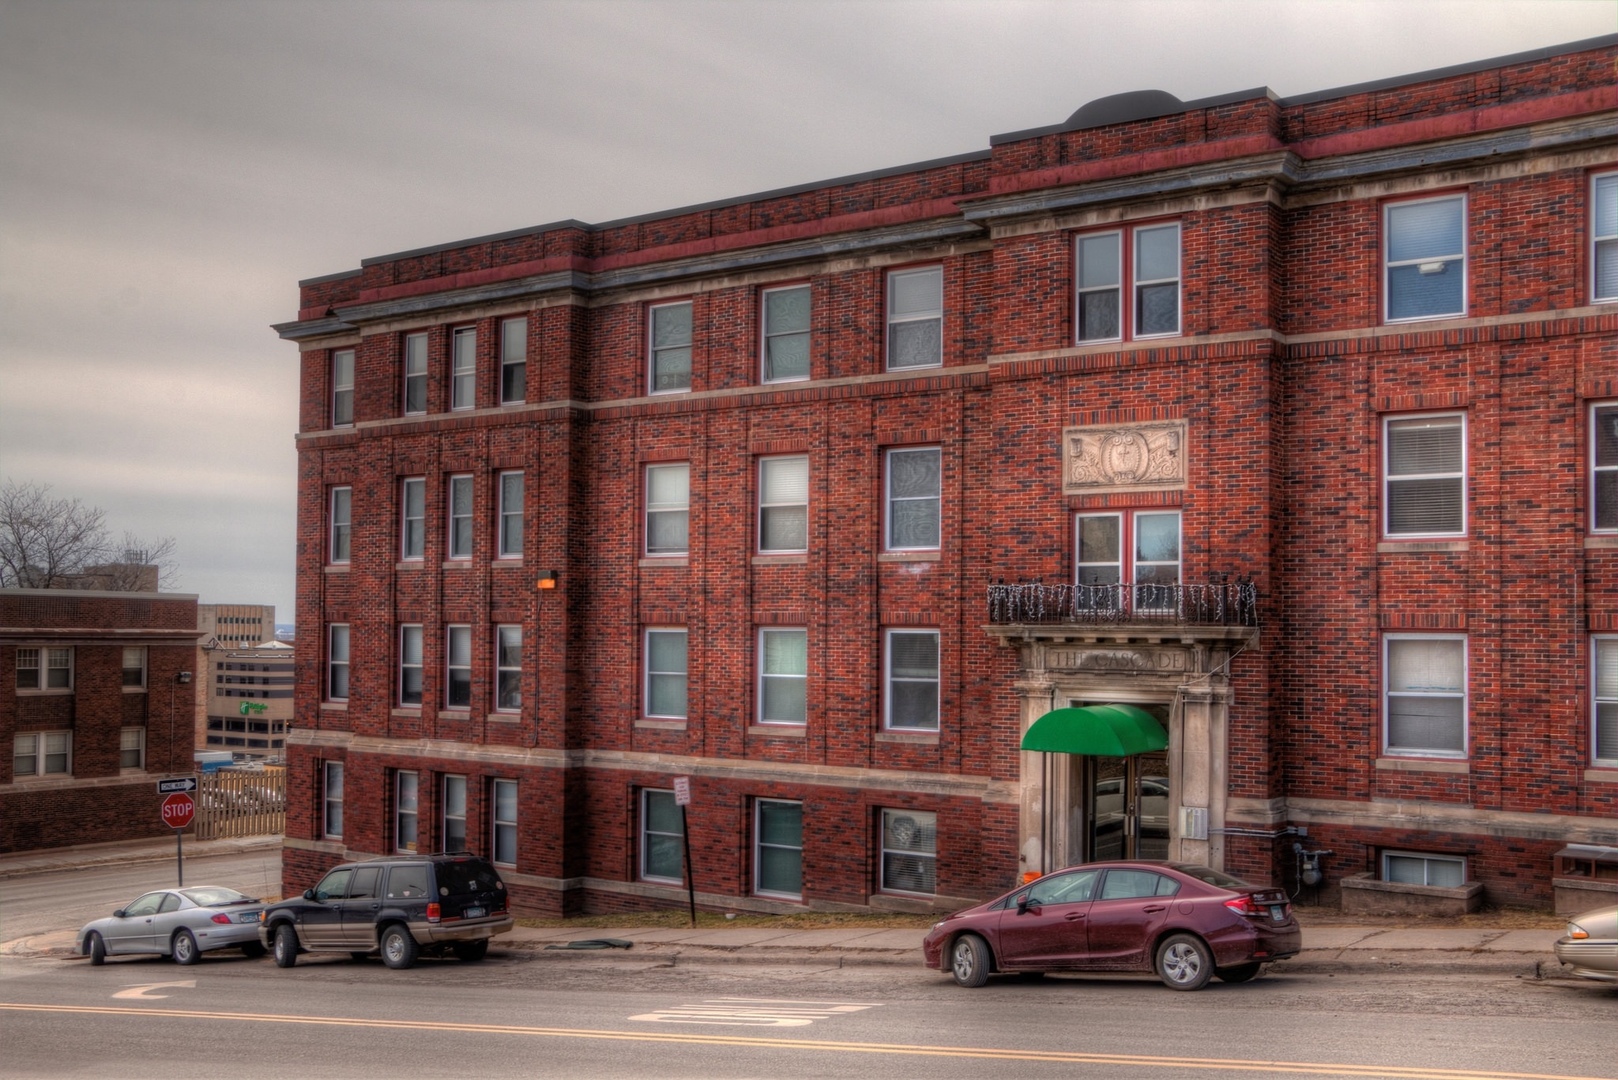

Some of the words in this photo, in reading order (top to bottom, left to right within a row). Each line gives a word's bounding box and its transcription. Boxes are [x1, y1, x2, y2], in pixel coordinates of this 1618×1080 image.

[1054, 651, 1089, 667] THE
[1094, 652, 1184, 669] CASCADE
[164, 803, 192, 817] STOP
